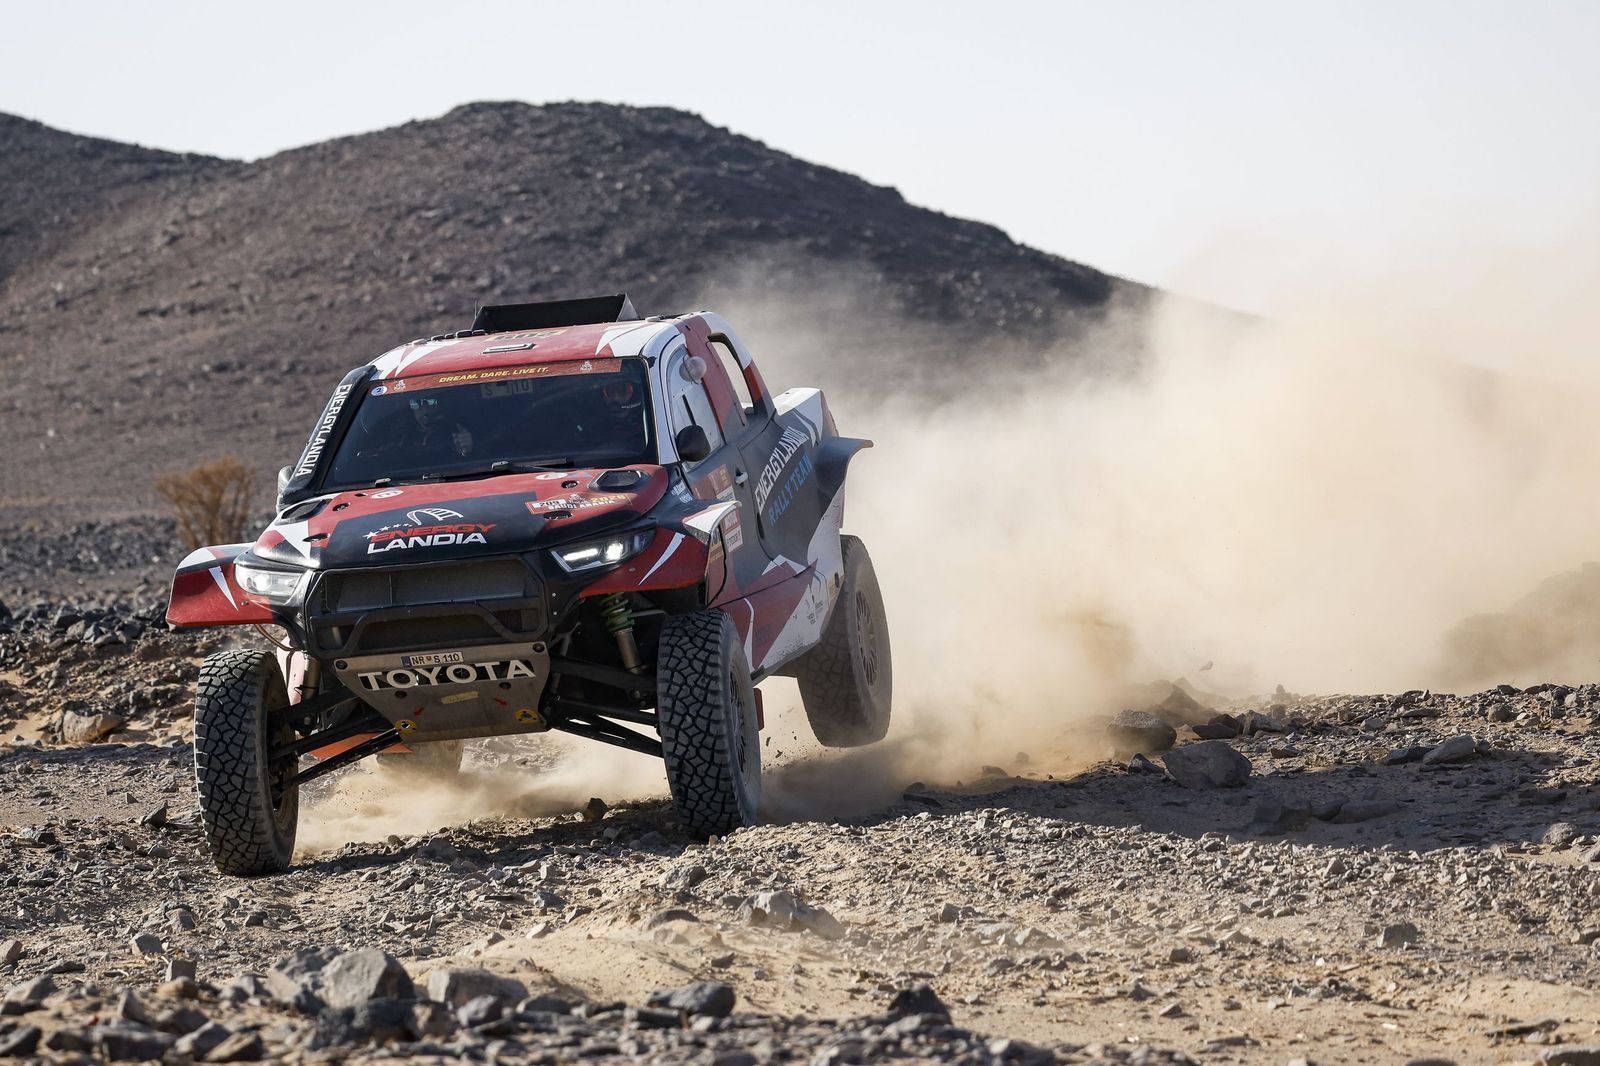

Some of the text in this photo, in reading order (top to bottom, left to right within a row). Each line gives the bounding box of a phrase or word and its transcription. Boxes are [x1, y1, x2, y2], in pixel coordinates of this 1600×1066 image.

[439, 374, 478, 383] DREAM.
[480, 370, 511, 379] DARE.
[513, 368, 536, 376] LIVE
[295, 384, 352, 477] ENERGYLANDIA
[754, 425, 810, 516] ENERGYLANDIA
[768, 451, 813, 527] RALLY TEAM
[367, 532, 488, 555] LANDIA
[371, 524, 497, 543] ENERGY
[411, 653, 460, 665] NR S 110
[357, 659, 536, 691] TOYOTA
